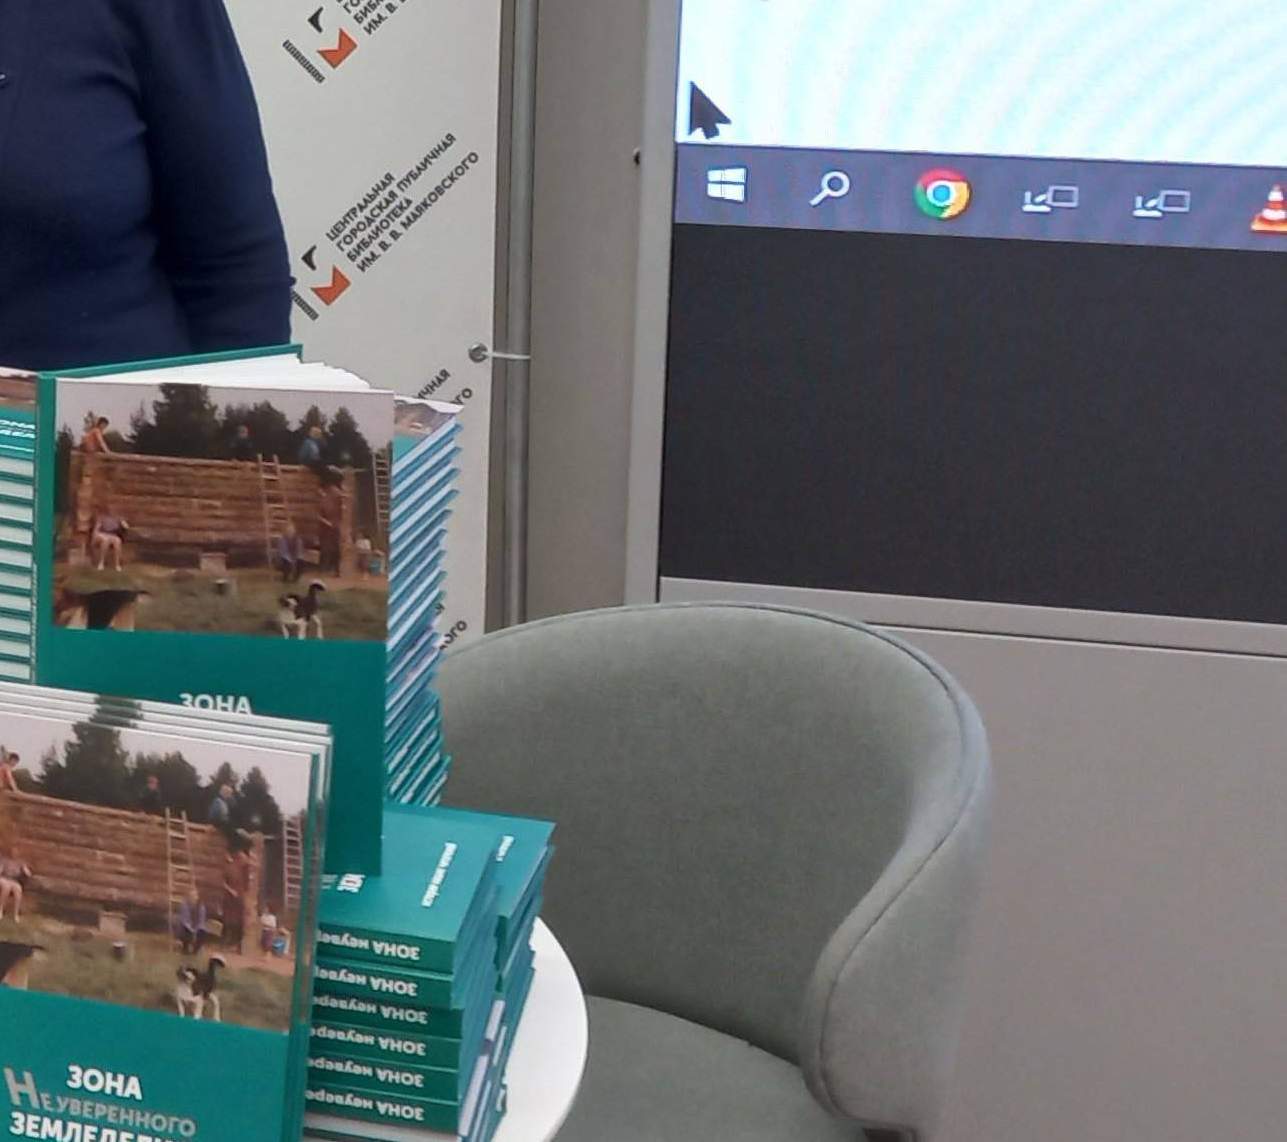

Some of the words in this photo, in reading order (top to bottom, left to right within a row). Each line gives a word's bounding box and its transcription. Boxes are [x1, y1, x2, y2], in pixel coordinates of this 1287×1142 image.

[364, 13, 387, 35] ИМ.
[336, 190, 398, 252] ГОРОДСКАЯ
[397, 133, 456, 192] ПУБЛИЧНАЯ
[326, 172, 395, 241] ЦЕНТРАЛЬНАЯ
[357, 251, 381, 273] ИМ.
[400, 152, 478, 230] МАЯКОВСКОГО
[347, 198, 413, 262] БИБЛИОТЕКА
[372, 940, 421, 961] ЗОНА
[369, 976, 418, 996] ЗОНА
[380, 1004, 428, 1025] ЗОНА
[378, 1036, 426, 1056] ЗОНА
[66, 1064, 143, 1101] ЗОНА
[376, 1068, 425, 1088] ЗОНА
[376, 1101, 425, 1121] ЗОНА
